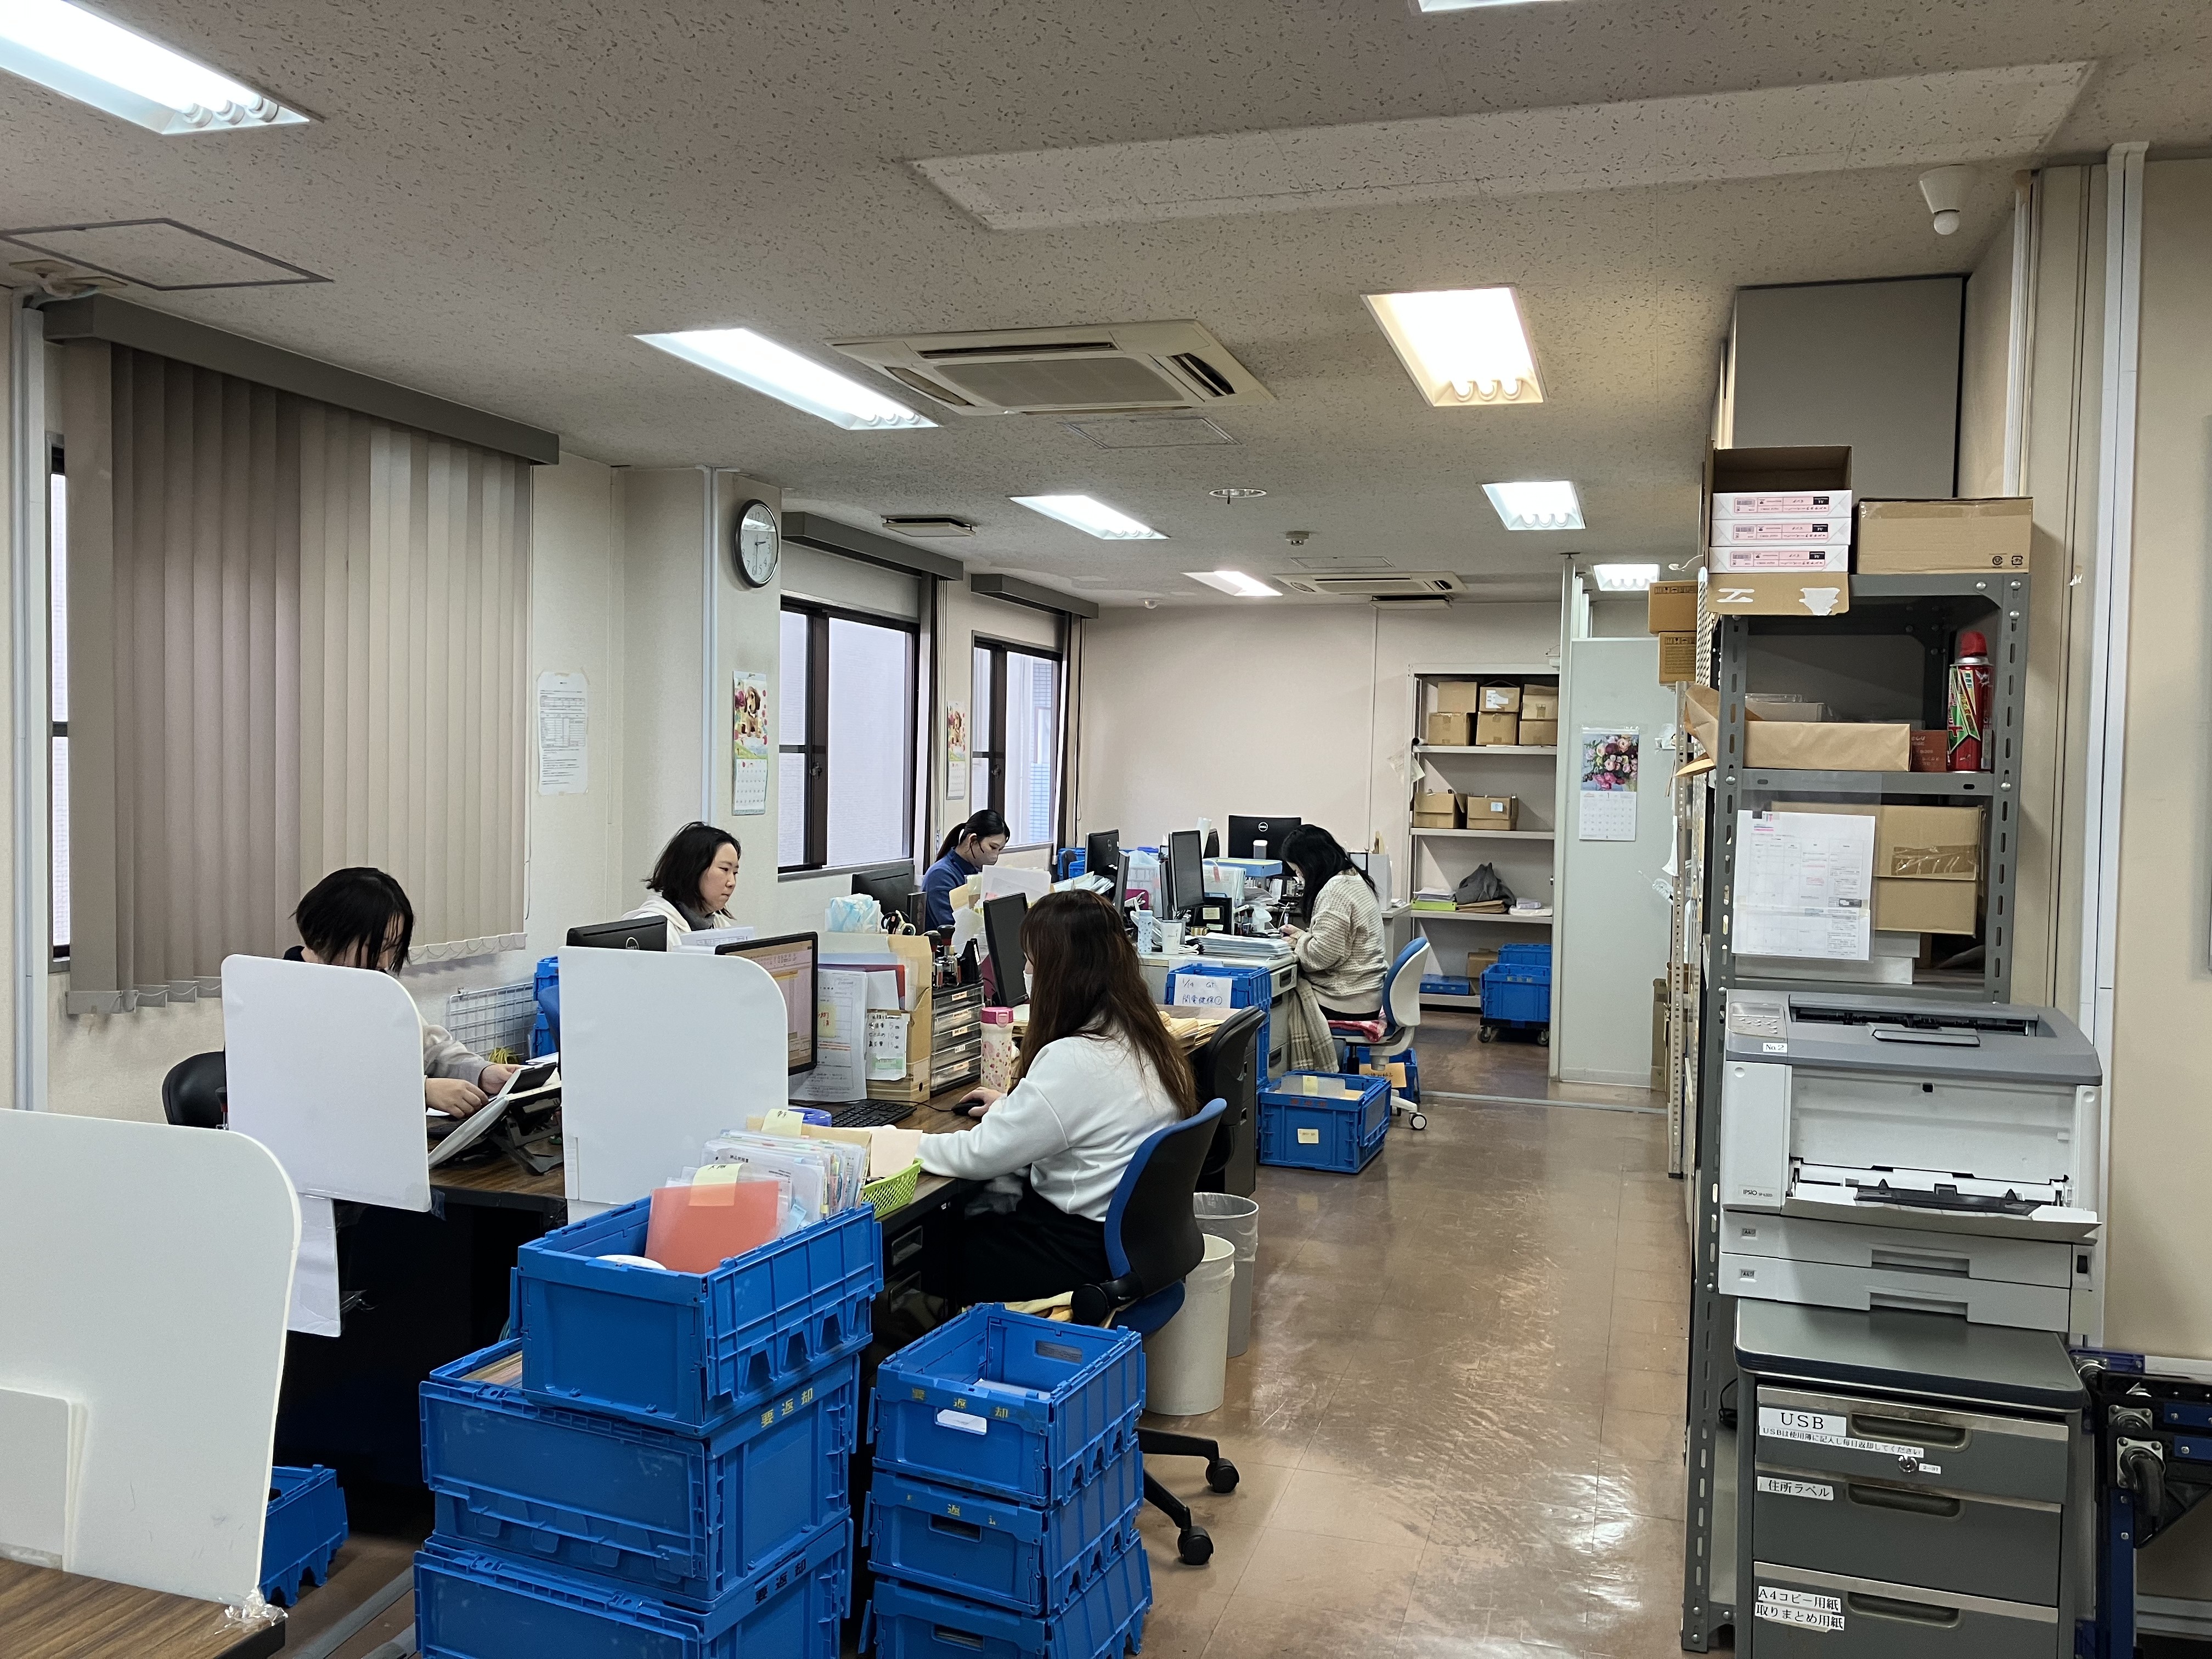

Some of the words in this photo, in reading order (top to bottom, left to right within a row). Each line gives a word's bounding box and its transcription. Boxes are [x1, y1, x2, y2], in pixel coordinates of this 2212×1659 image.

[758, 564, 763, 575] 5
[1780, 1412, 1824, 1430] USB
[1768, 1479, 1830, 1497] 住所ラベル
[1758, 1588, 1838, 1611] A4コピー用紙
[1756, 1604, 1843, 1629] 取りまとめ用紙
